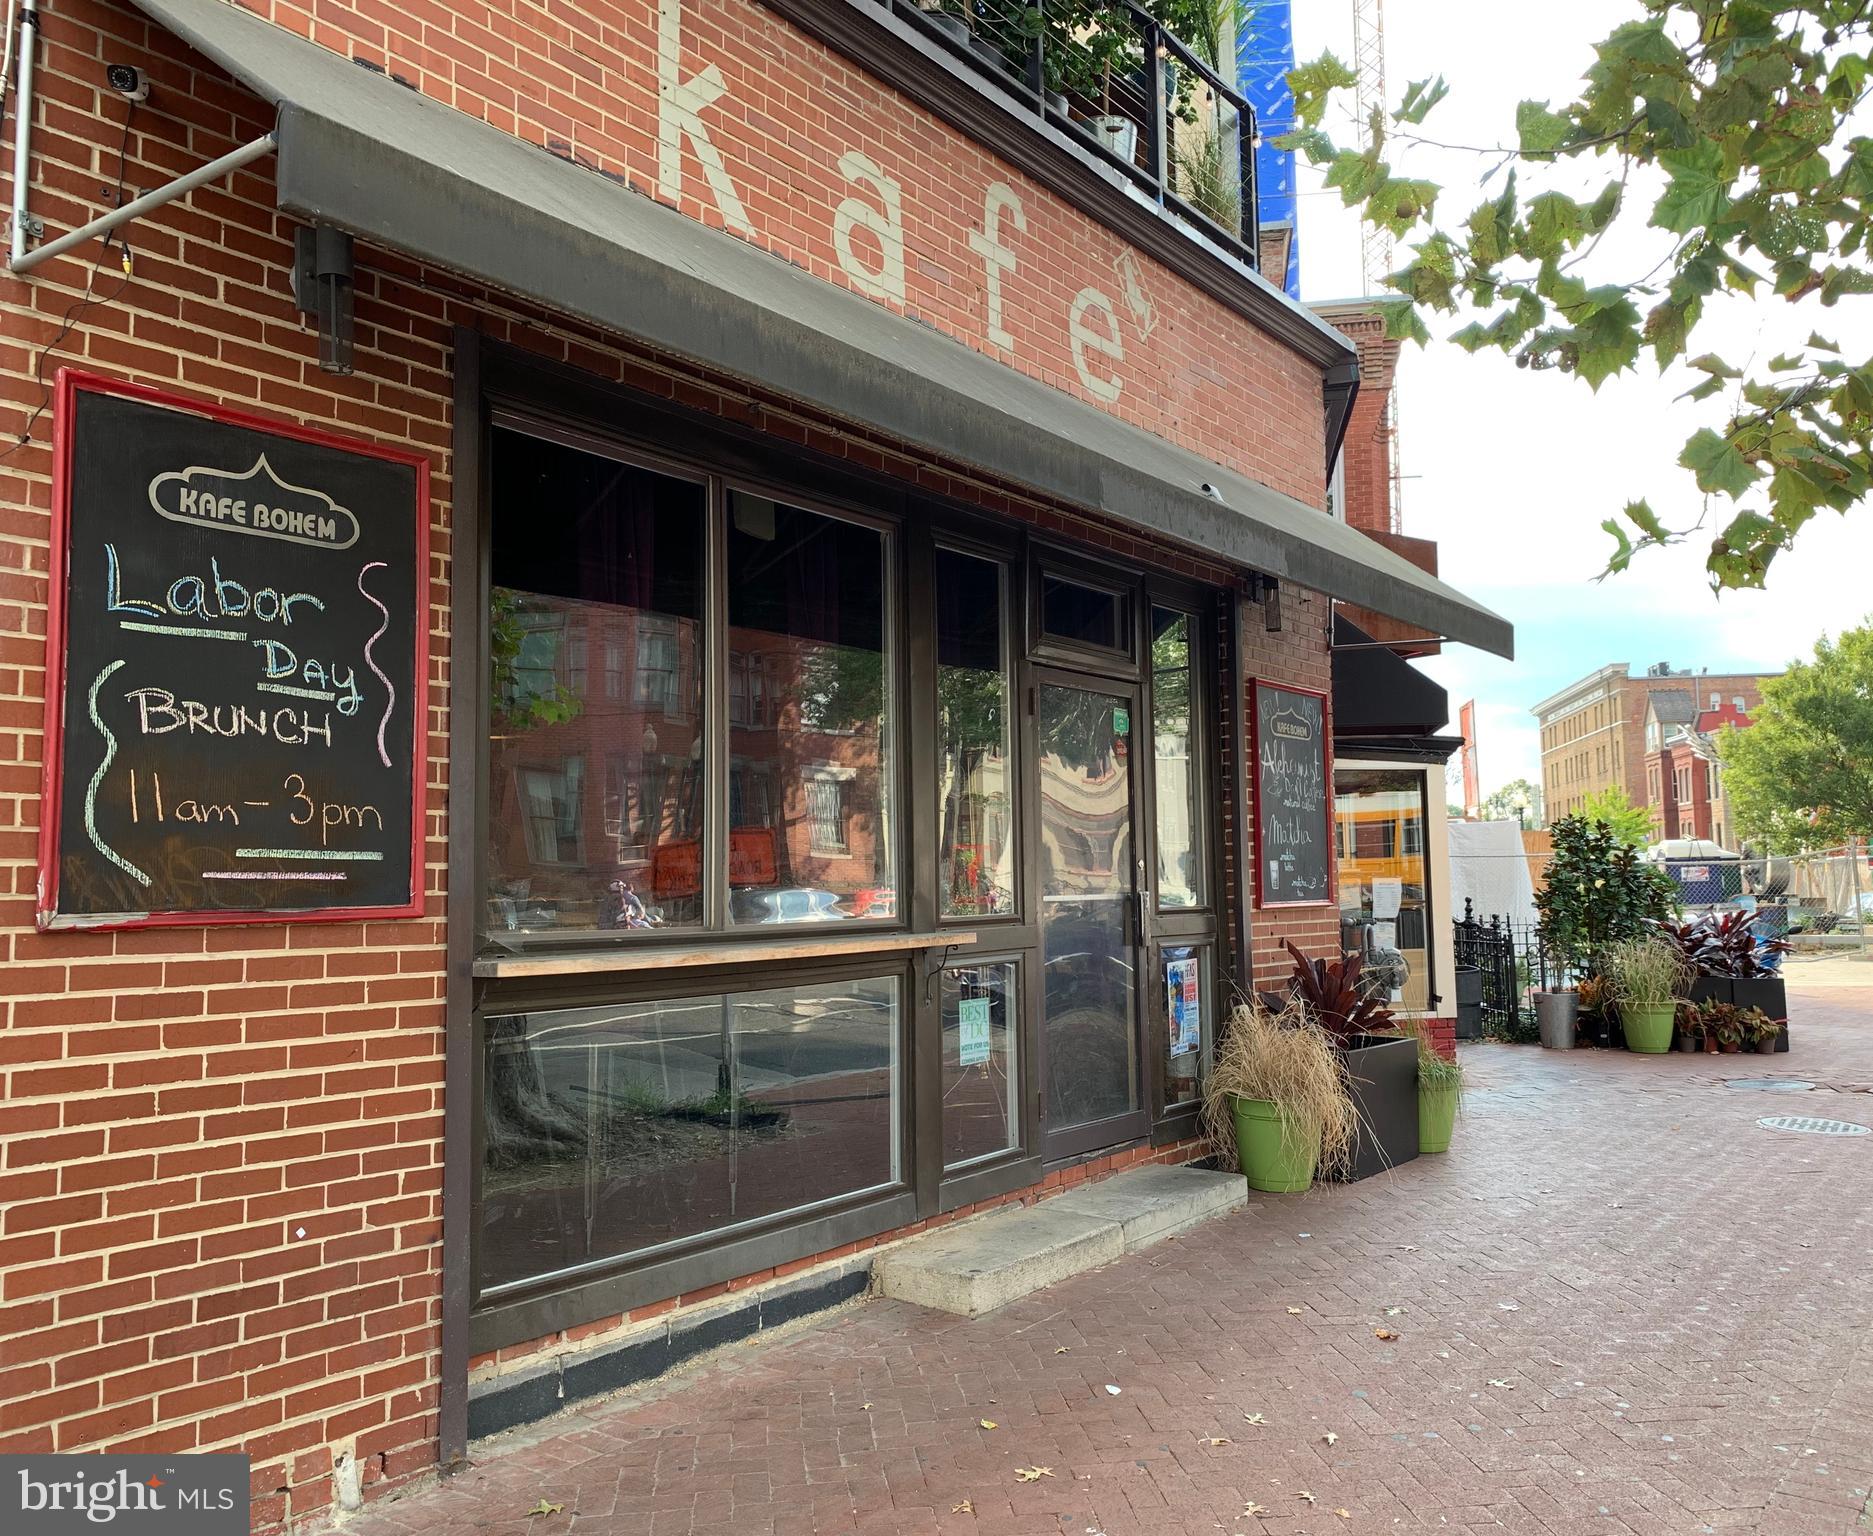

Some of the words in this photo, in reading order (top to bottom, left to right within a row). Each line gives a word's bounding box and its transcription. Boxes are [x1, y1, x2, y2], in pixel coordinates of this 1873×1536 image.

[179, 487, 246, 525] KAFE
[253, 503, 337, 541] BOHEM
[104, 542, 325, 625] Labor
[124, 687, 332, 748] BRUNCH
[961, 1004, 987, 1023] BEST
